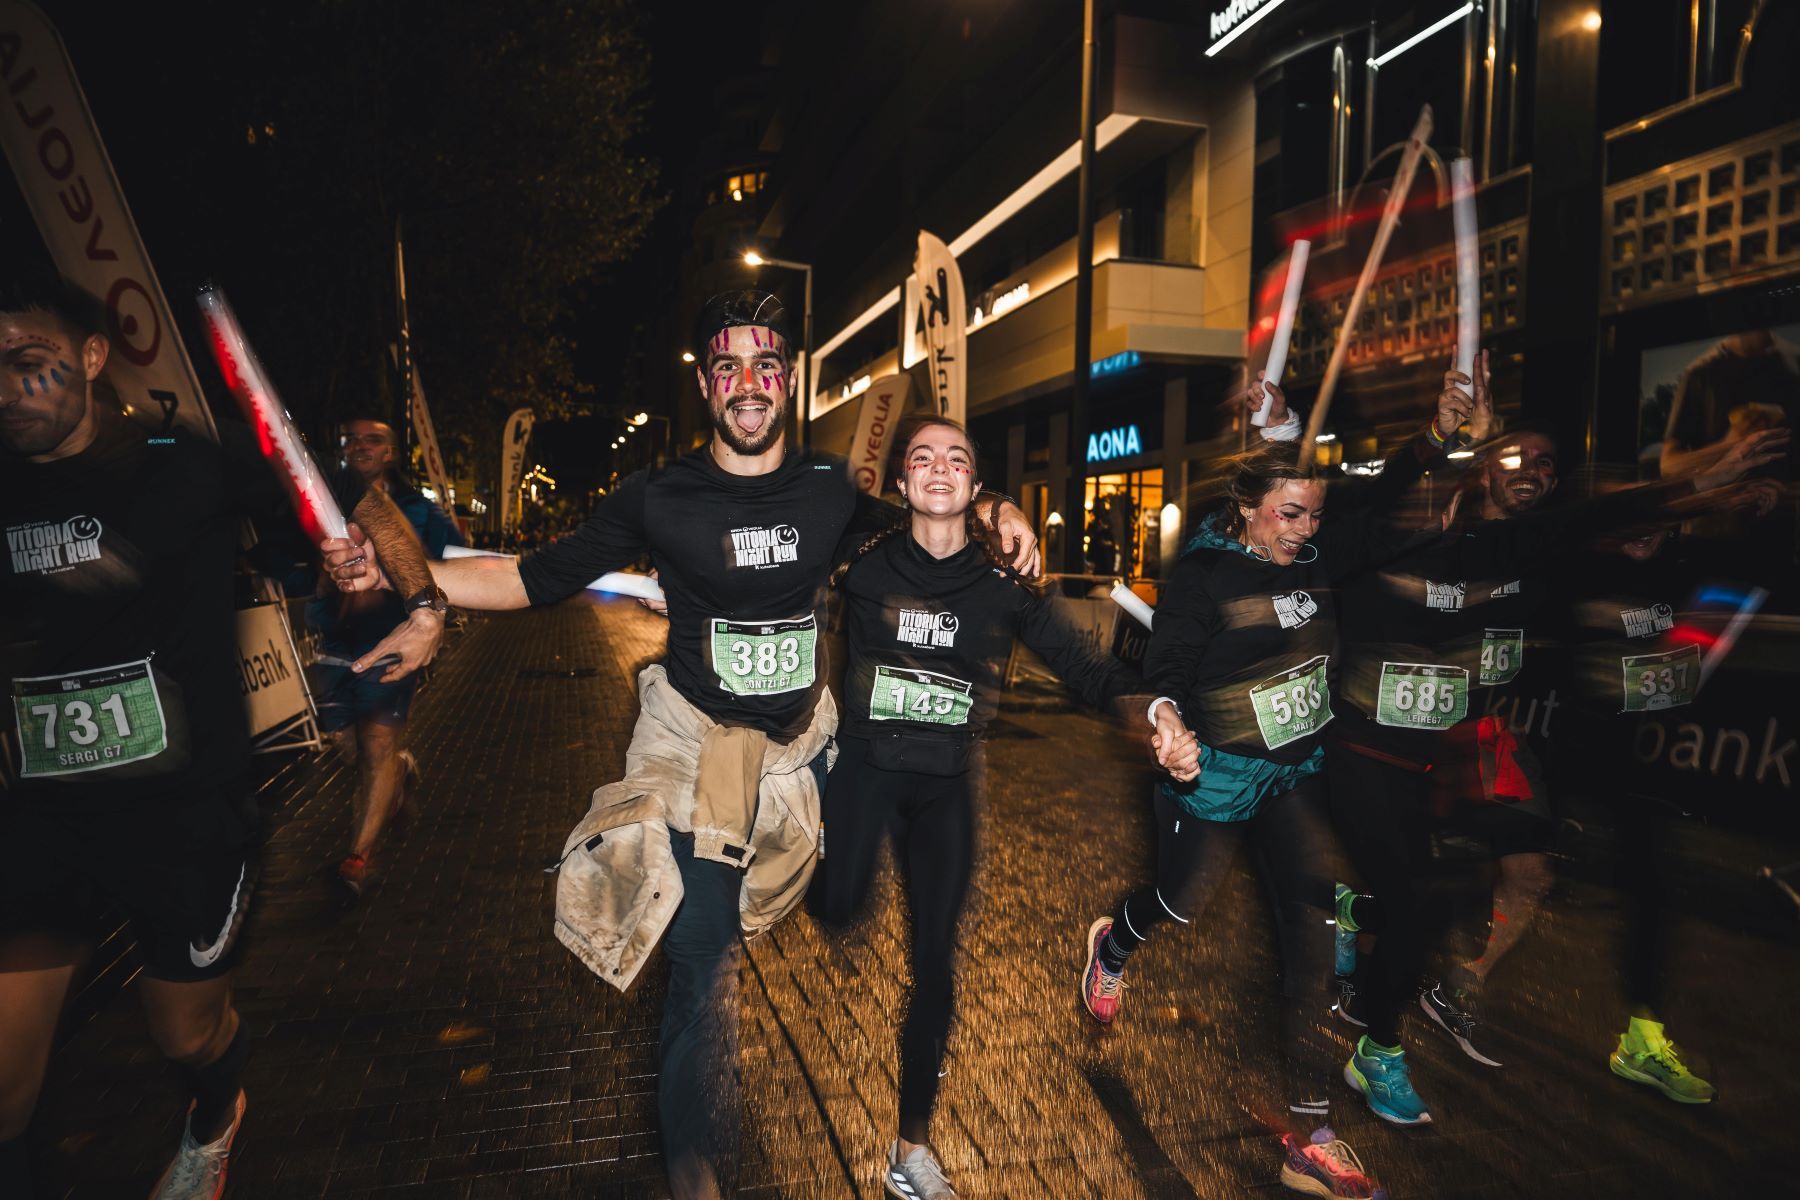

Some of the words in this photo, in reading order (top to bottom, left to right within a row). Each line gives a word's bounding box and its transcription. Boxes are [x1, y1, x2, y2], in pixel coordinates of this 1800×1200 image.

[863, 392, 894, 463] VEOLIA
[1086, 424, 1141, 463] AONA
[6, 522, 74, 552] VITORIA
[731, 529, 779, 550] VITORIA
[11, 545, 63, 574] NIGHT
[65, 538, 102, 565] RUN
[735, 547, 771, 567] NIGHT
[773, 544, 798, 563] RUN
[899, 612, 940, 631] VITORIA
[1620, 607, 1659, 627] VITORIA
[896, 626, 931, 645] NIGHT
[931, 630, 955, 648] RUN
[731, 637, 800, 676] 383
[1640, 662, 1689, 697] 337
[891, 685, 955, 715] 145
[1396, 680, 1455, 714] 685
[31, 693, 131, 749] 731
[60, 749, 99, 766] SERGI
[104, 744, 122, 759] G7
